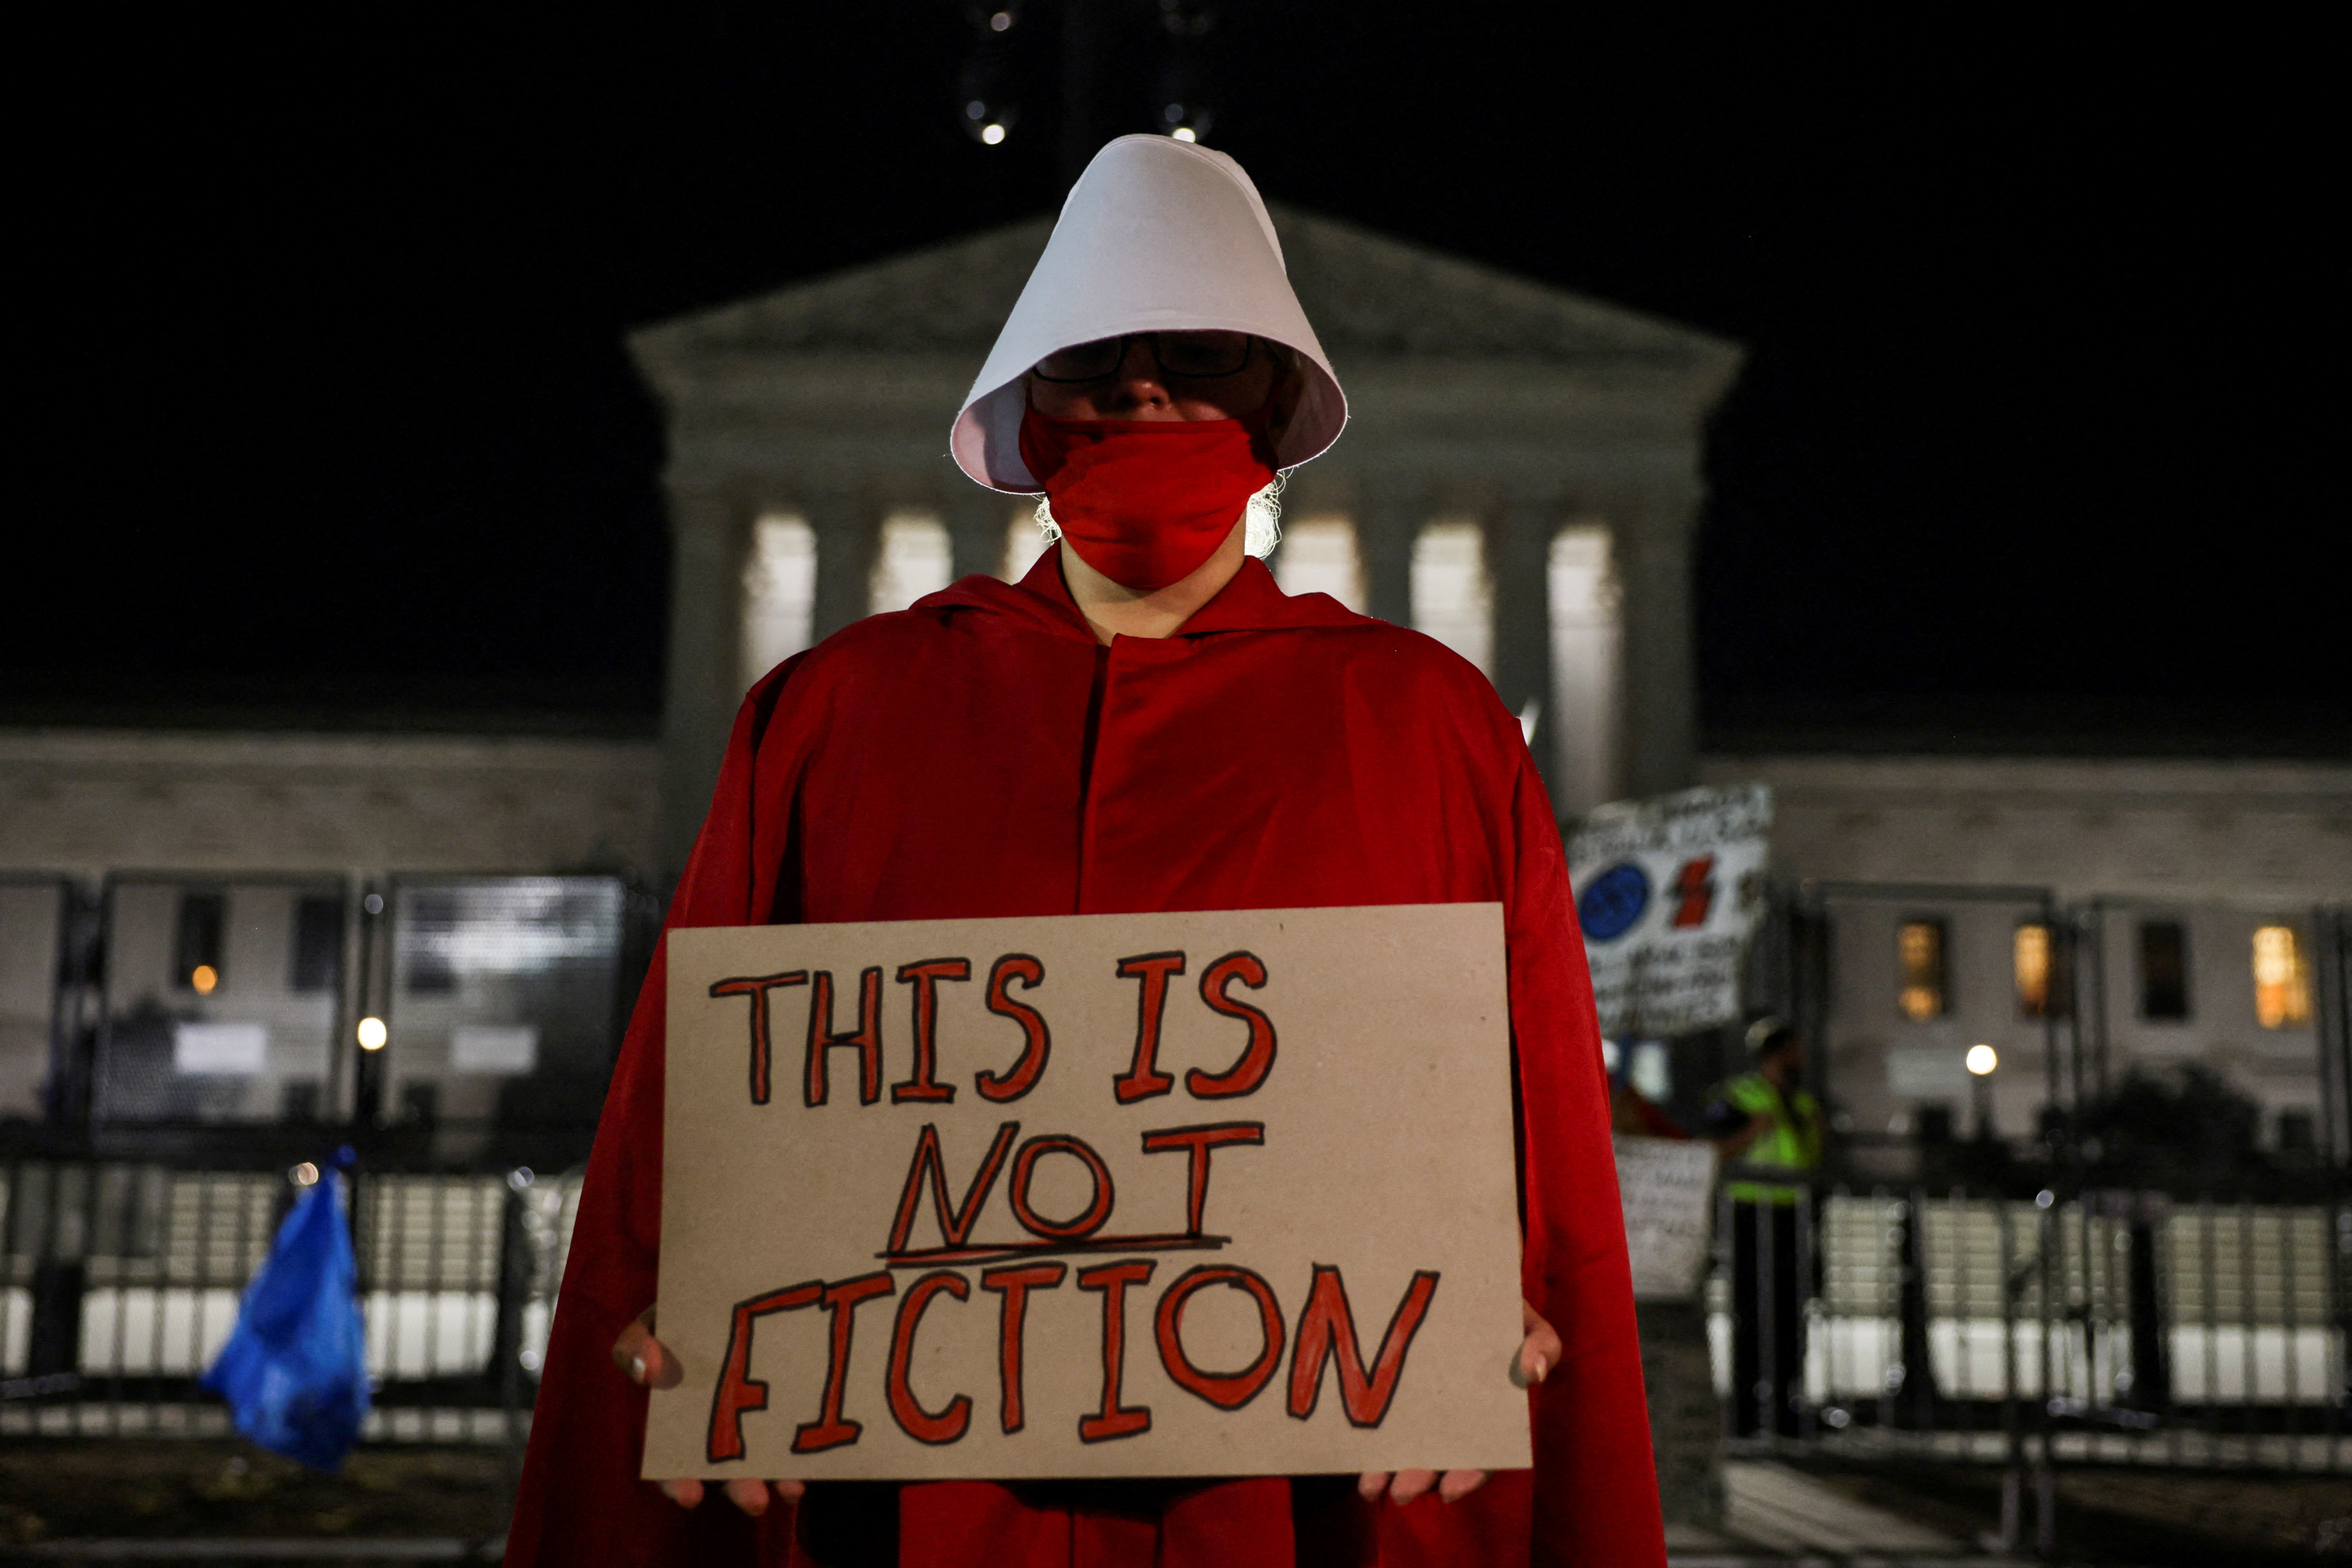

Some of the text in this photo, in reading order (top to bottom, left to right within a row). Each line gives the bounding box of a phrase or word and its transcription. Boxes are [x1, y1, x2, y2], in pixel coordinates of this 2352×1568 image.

[709, 950, 1277, 1108] THIS IS
[887, 1121, 1265, 1251] NOT
[706, 1259, 1440, 1464] FICTION
